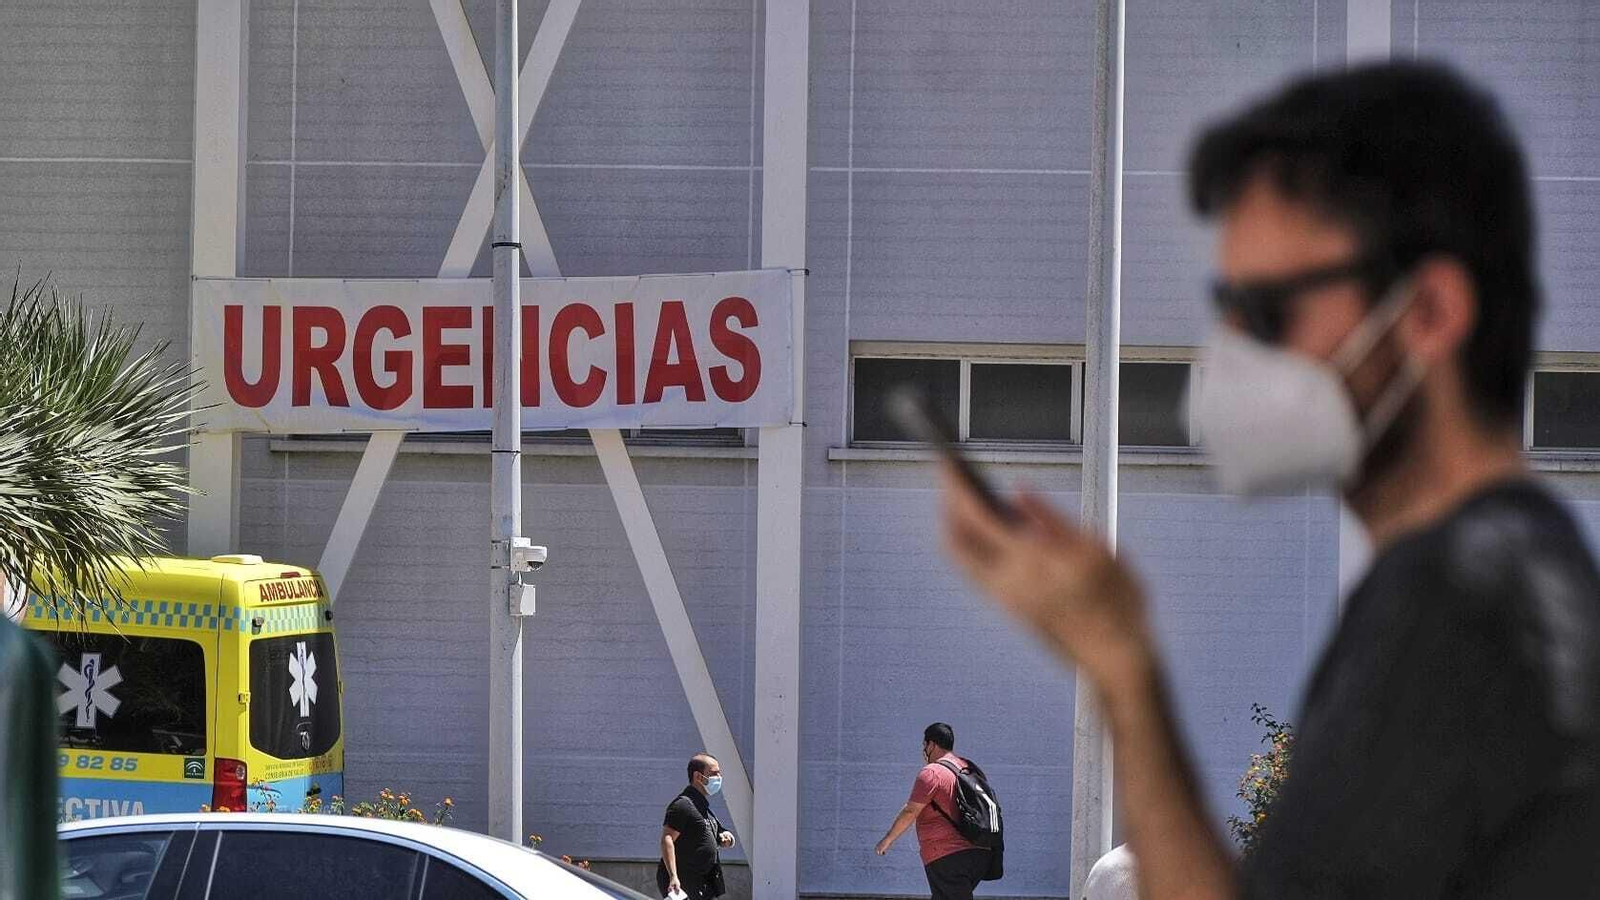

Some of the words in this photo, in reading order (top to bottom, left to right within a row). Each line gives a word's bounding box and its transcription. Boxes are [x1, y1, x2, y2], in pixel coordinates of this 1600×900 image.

[223, 296, 762, 410] URGENCIAS
[259, 579, 324, 603] AMBULANCIA
[76, 755, 105, 770] 82
[109, 756, 138, 772] 85
